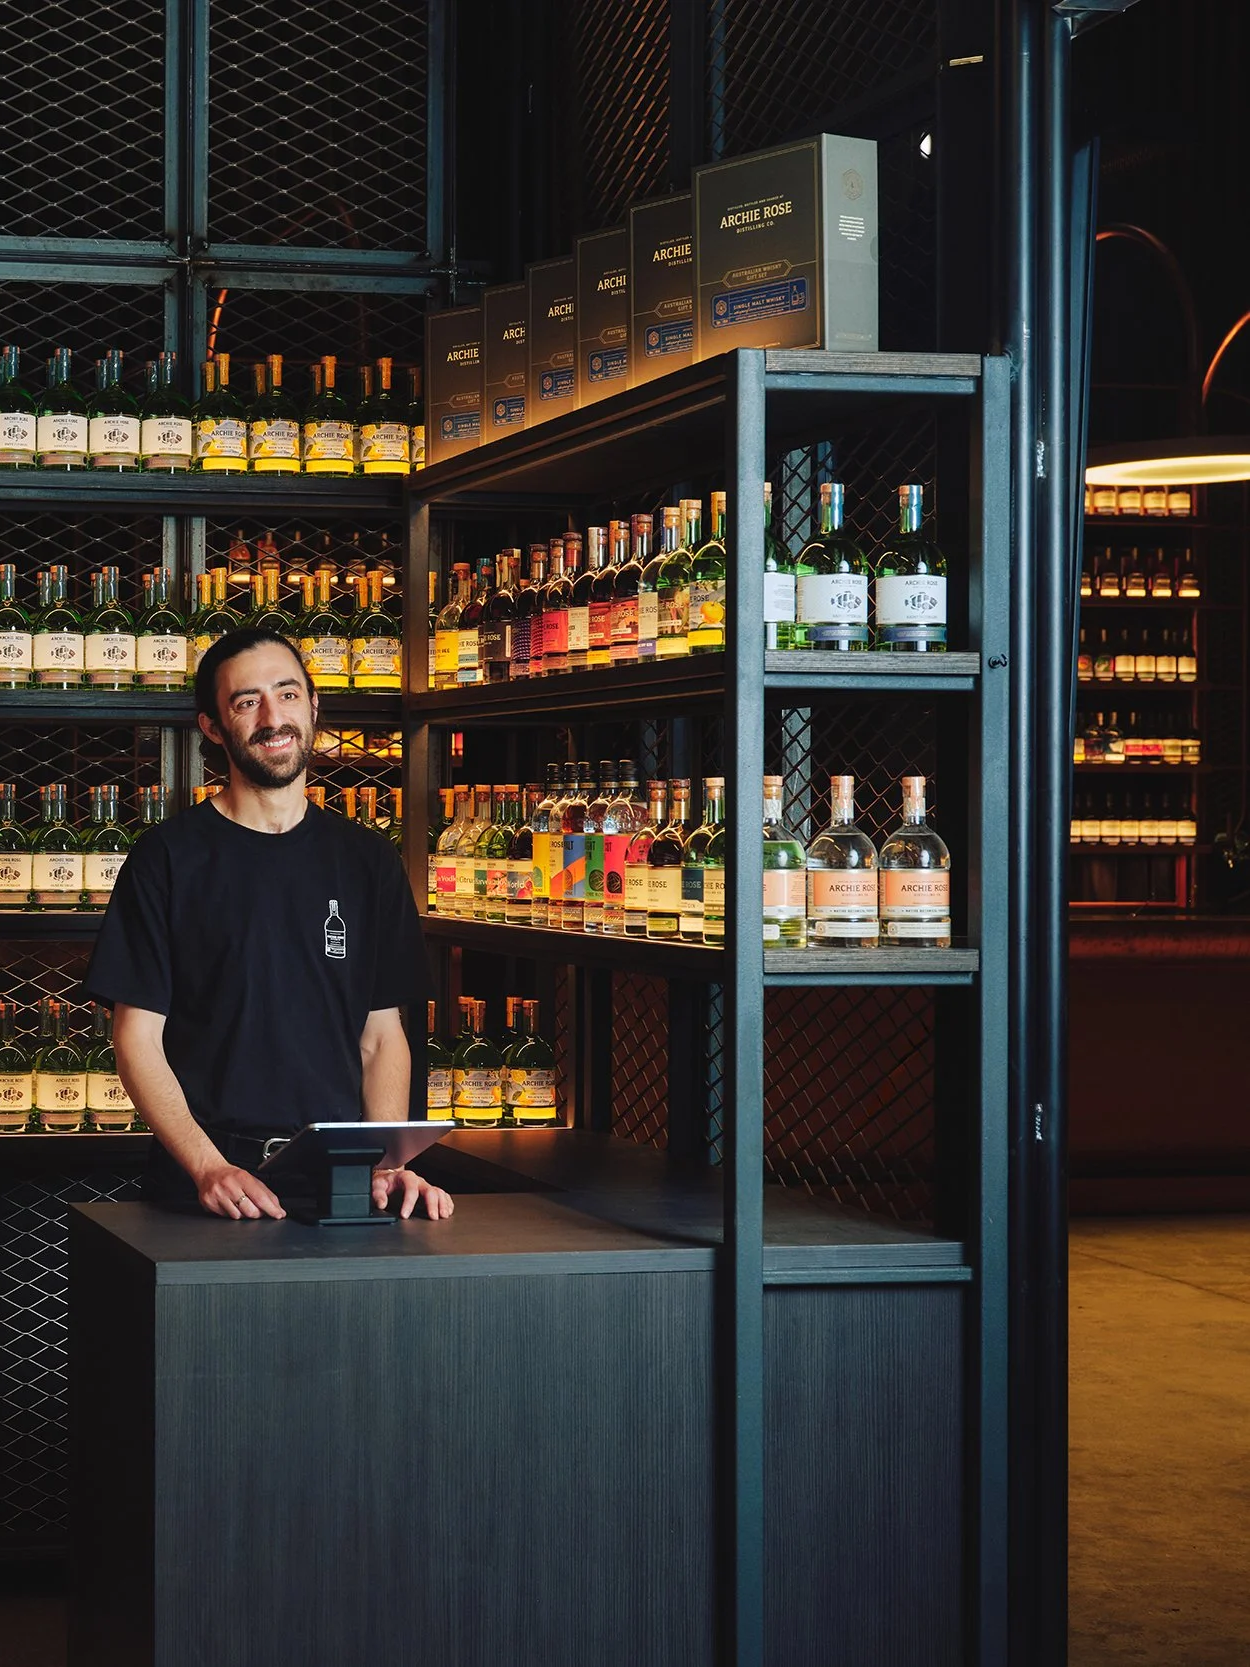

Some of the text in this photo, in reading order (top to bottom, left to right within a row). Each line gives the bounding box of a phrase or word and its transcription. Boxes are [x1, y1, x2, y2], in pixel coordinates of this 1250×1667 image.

[719, 208, 761, 229] ARCHIE
[763, 201, 793, 219] ROSE
[652, 244, 692, 262] ARCHIE
[732, 263, 782, 278] AUSTRALIAN WHISKY
[766, 295, 786, 304] WHISKY
[447, 348, 479, 362] ARCHIE
[618, 609, 634, 618] ROSE
